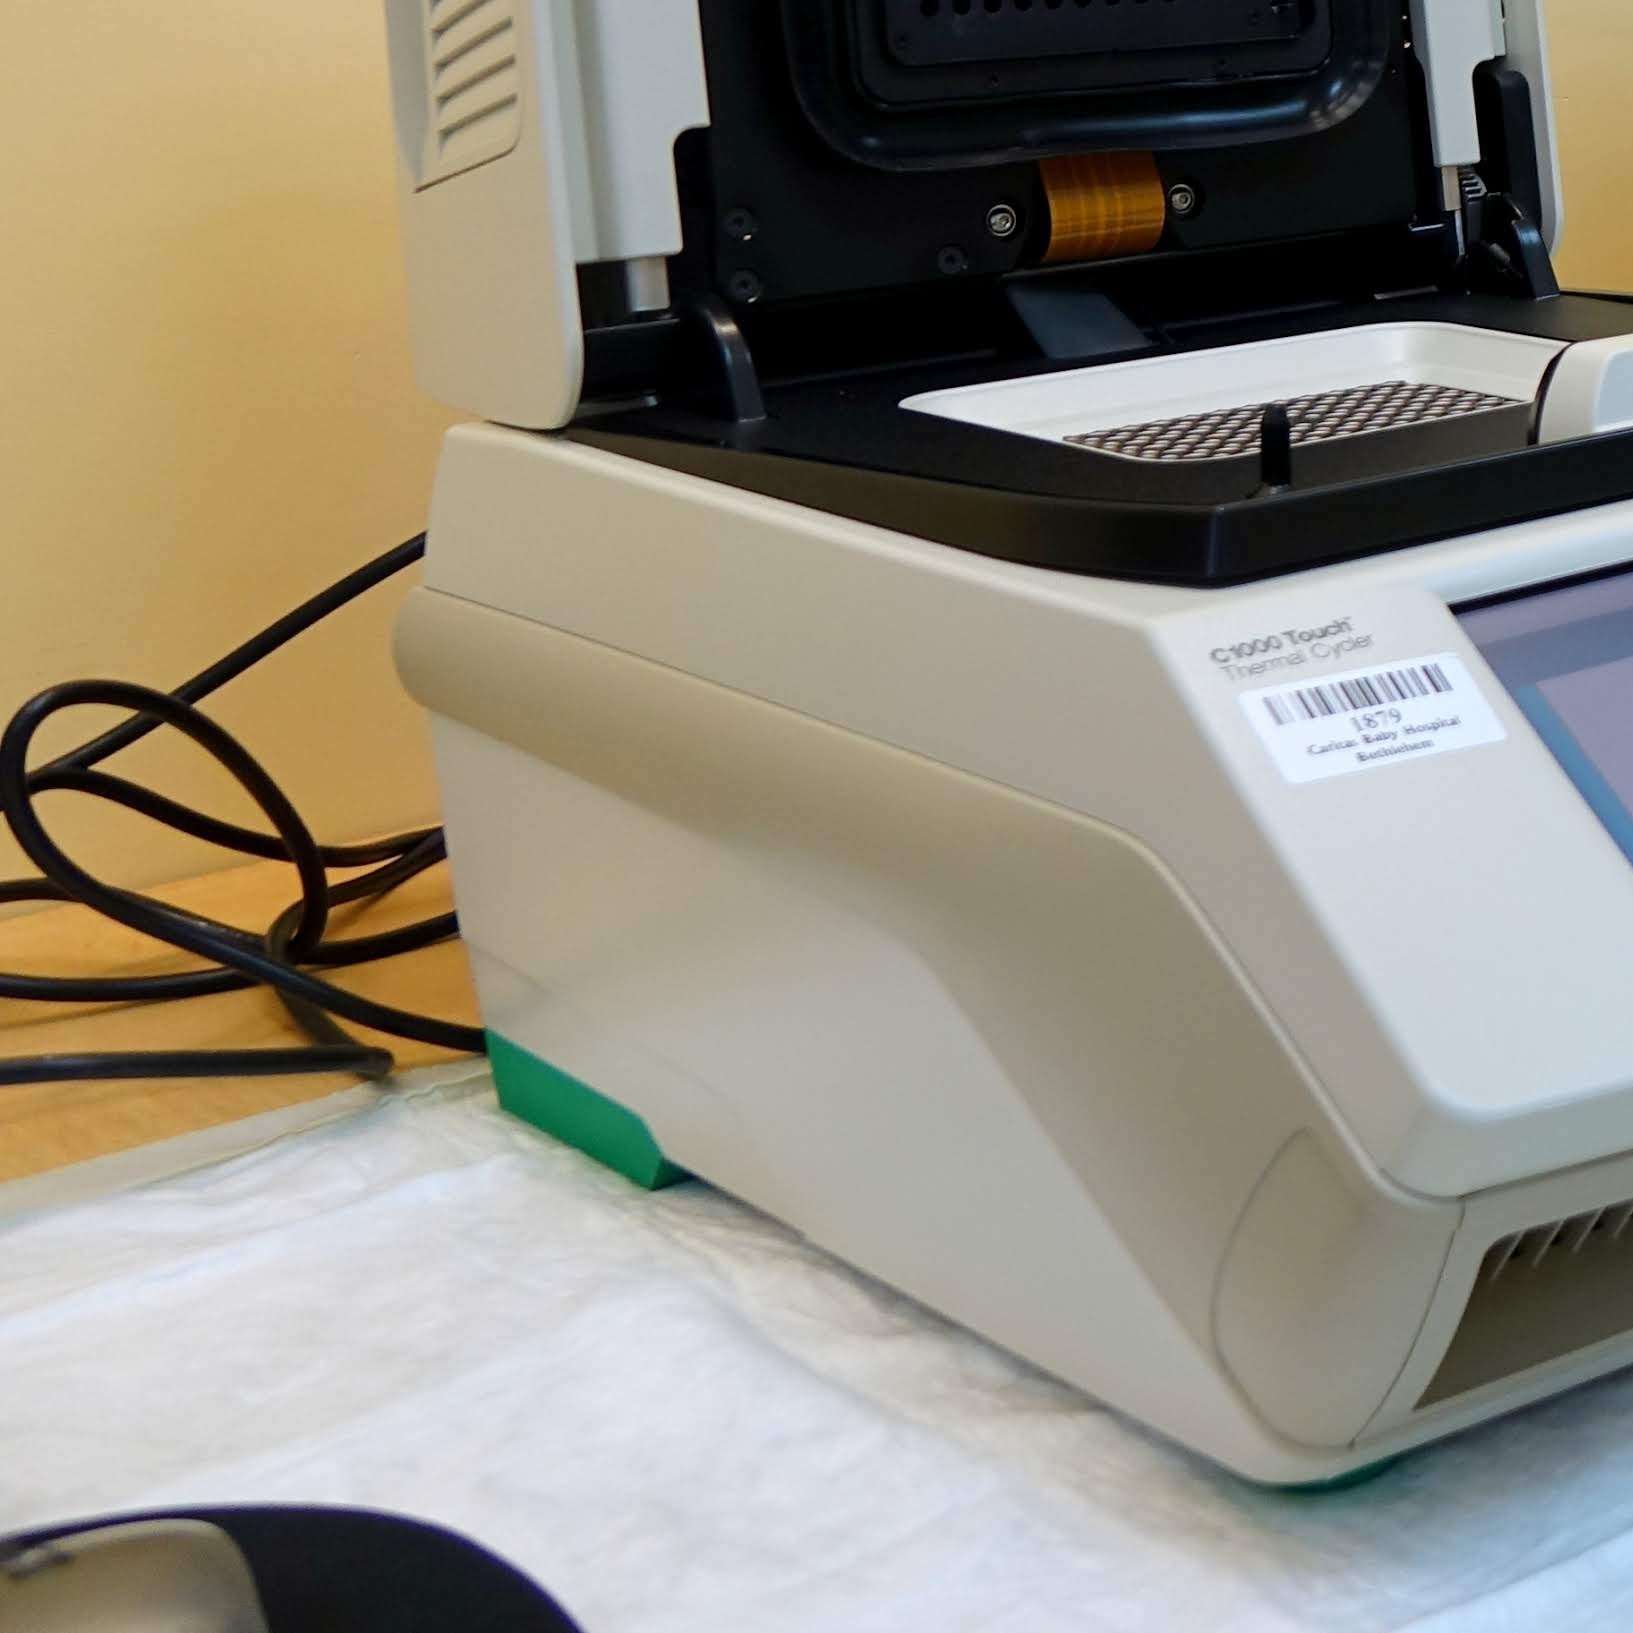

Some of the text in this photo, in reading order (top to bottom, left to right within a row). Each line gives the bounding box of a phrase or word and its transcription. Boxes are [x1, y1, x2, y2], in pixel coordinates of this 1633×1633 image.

[1209, 635, 1282, 663] C1000
[1219, 633, 1372, 681] Thermal Cycler
[1352, 707, 1402, 733] 1879
[1361, 730, 1398, 745] Baby
[1402, 715, 1462, 736] Hospital
[1356, 739, 1435, 763] Bethlehem
